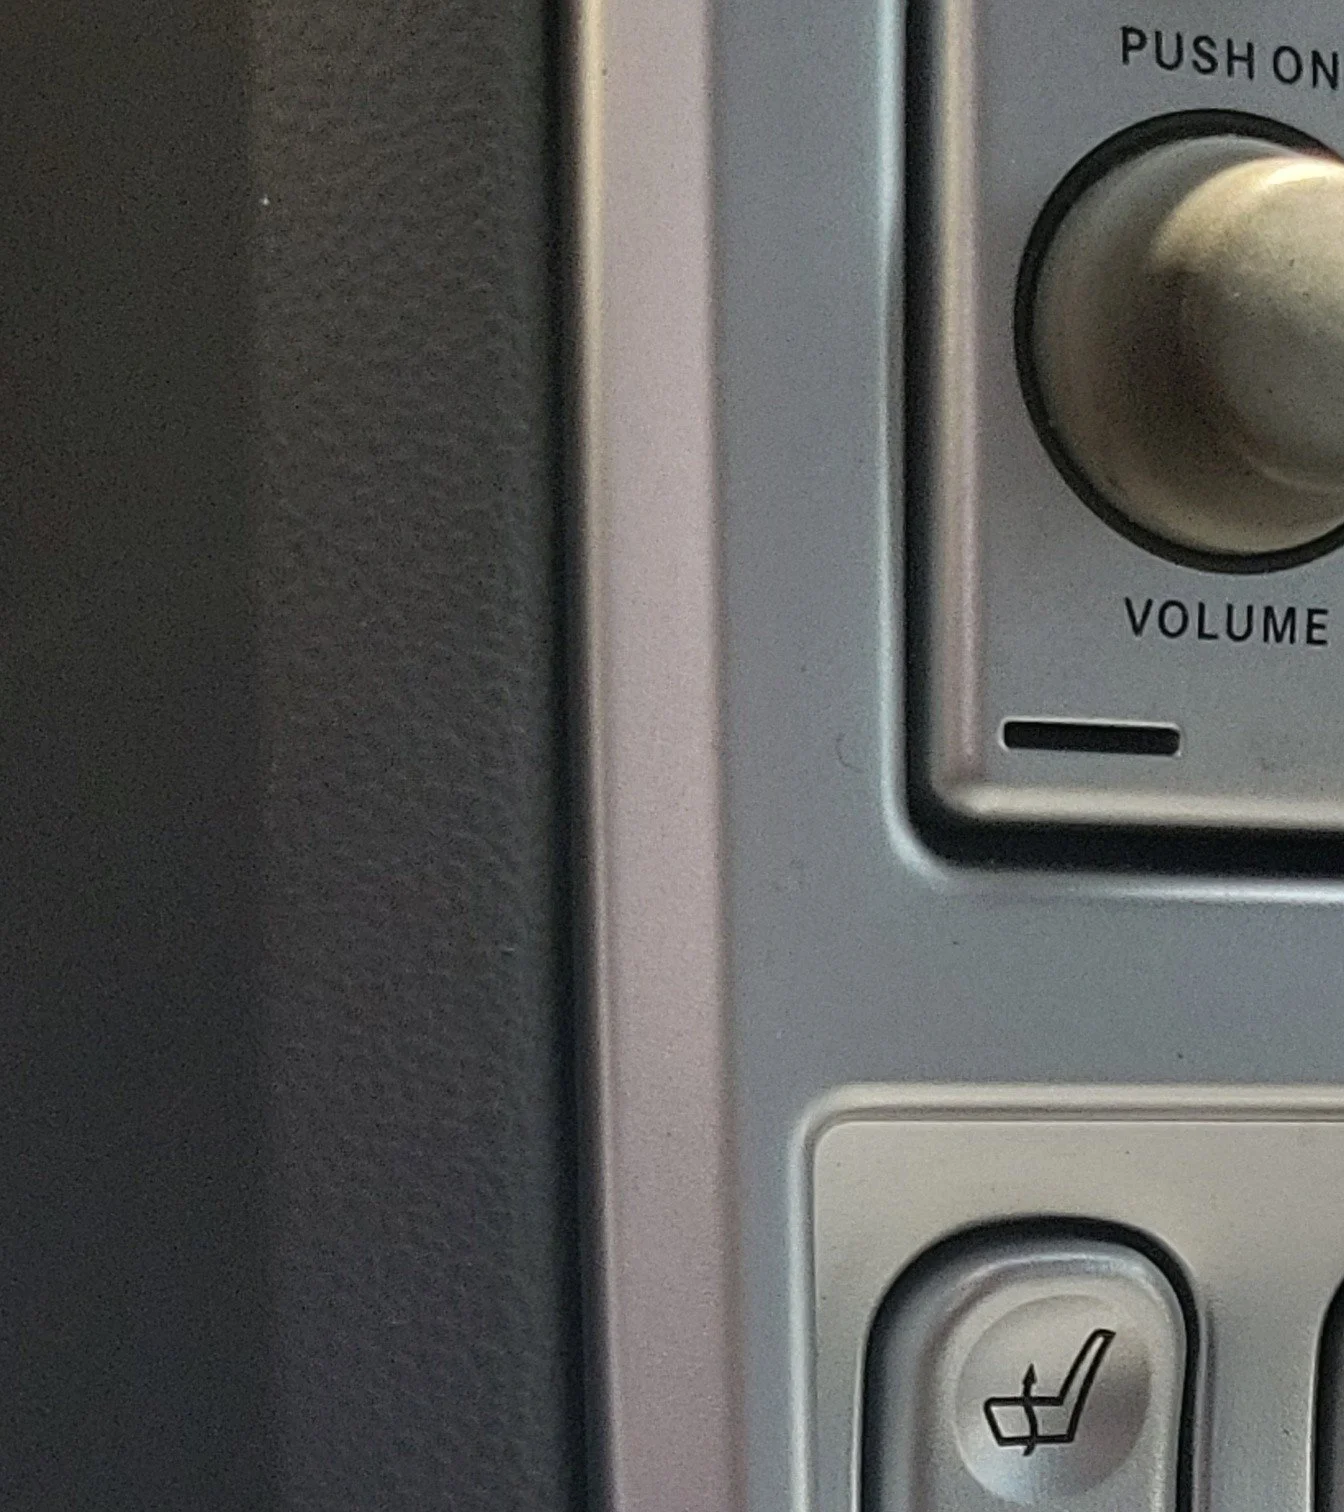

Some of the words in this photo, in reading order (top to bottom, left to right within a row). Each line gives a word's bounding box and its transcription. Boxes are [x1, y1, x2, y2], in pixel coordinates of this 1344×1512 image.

[1120, 26, 1256, 81] PUSH
[1272, 46, 1341, 91] ON
[1124, 596, 1330, 646] VOLUME
